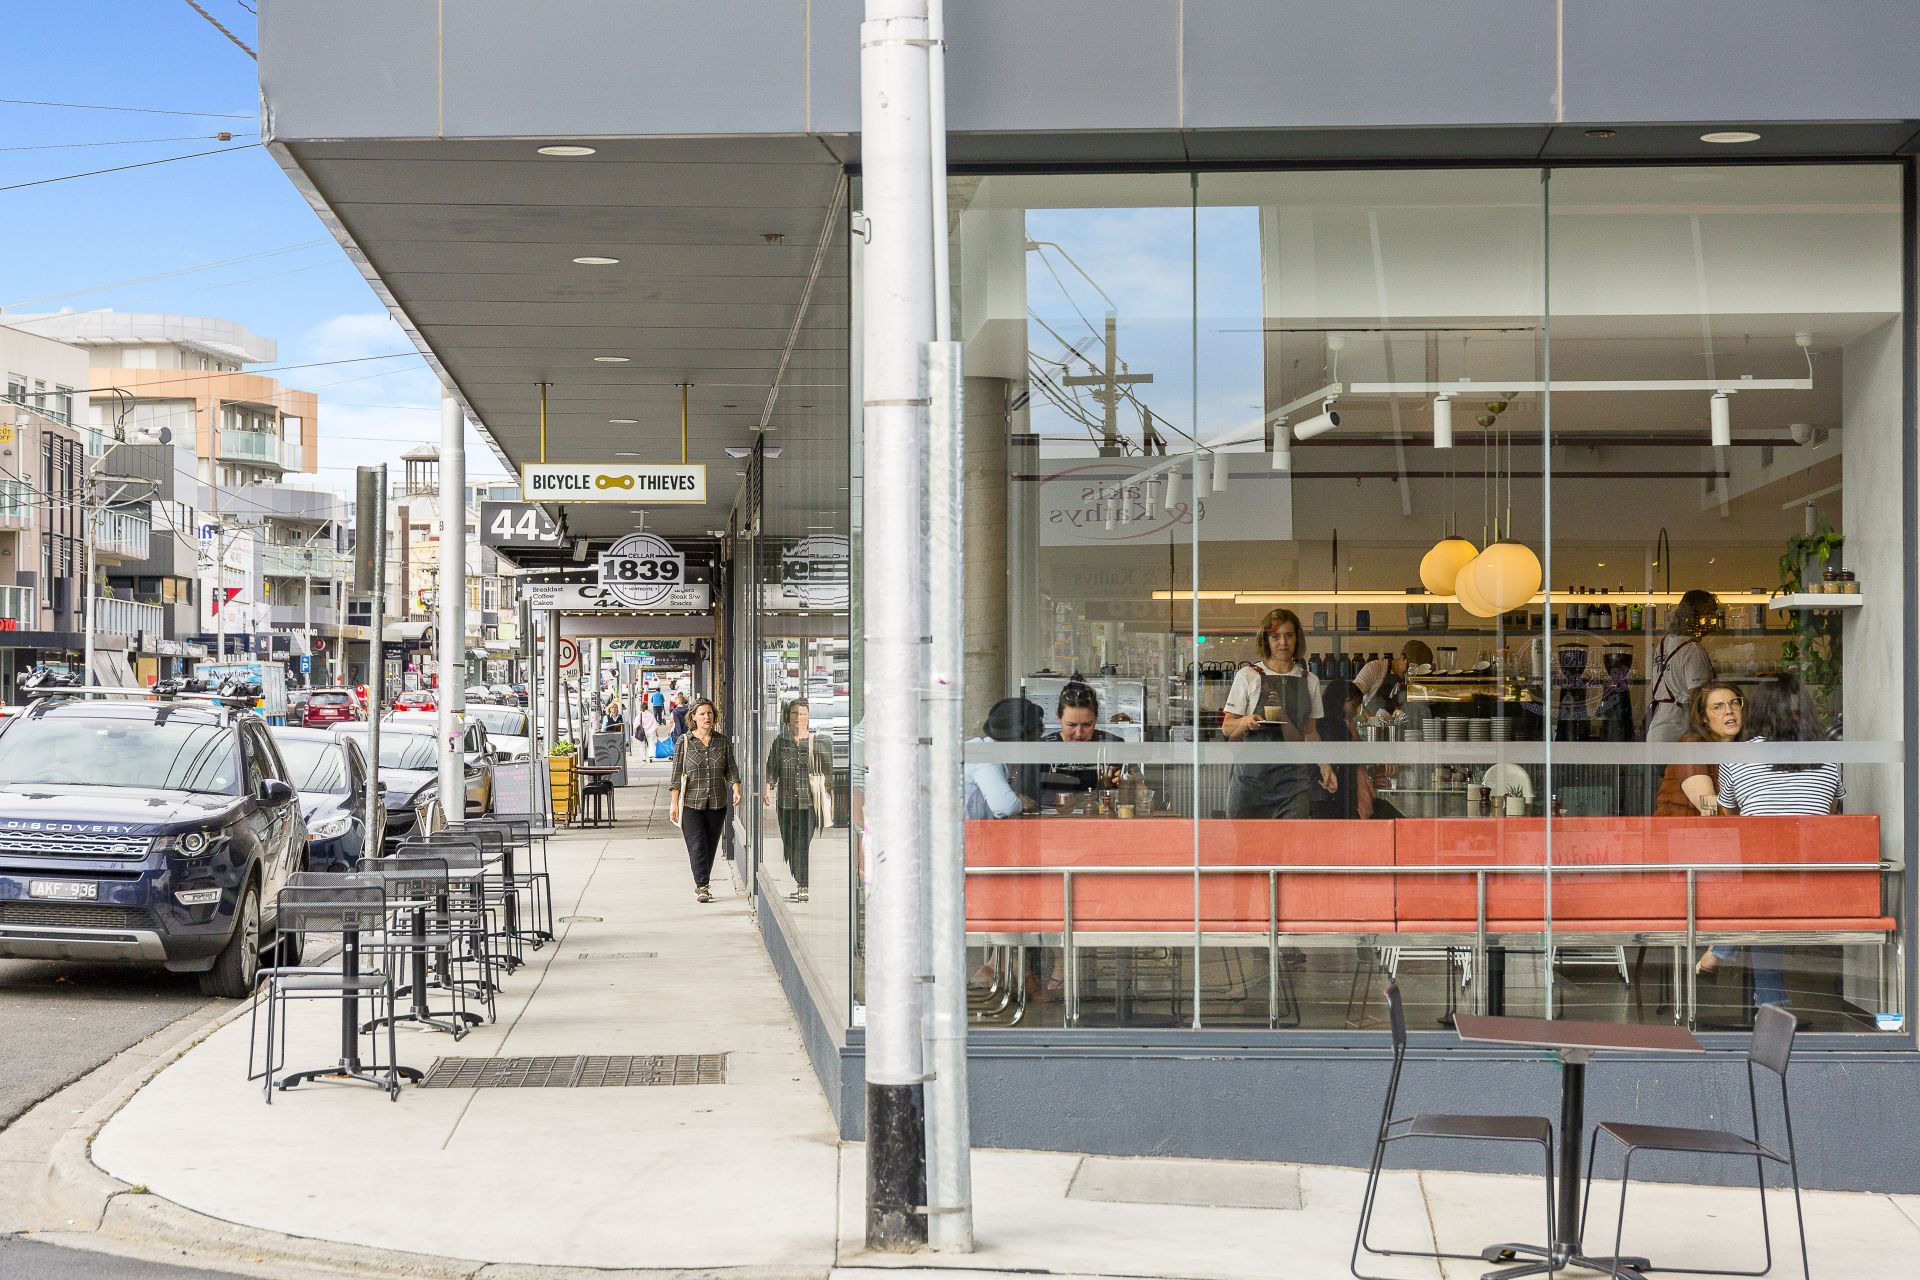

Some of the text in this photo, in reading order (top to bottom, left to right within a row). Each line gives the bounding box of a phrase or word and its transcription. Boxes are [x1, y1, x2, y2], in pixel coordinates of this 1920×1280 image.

[533, 474, 695, 490] BICYCLE THIEVES
[603, 559, 680, 581] 1839
[578, 585, 612, 599] CA
[302, 663, 309, 671] P
[8, 821, 134, 833] DISCOVERY
[37, 882, 96, 897] AKF 936
